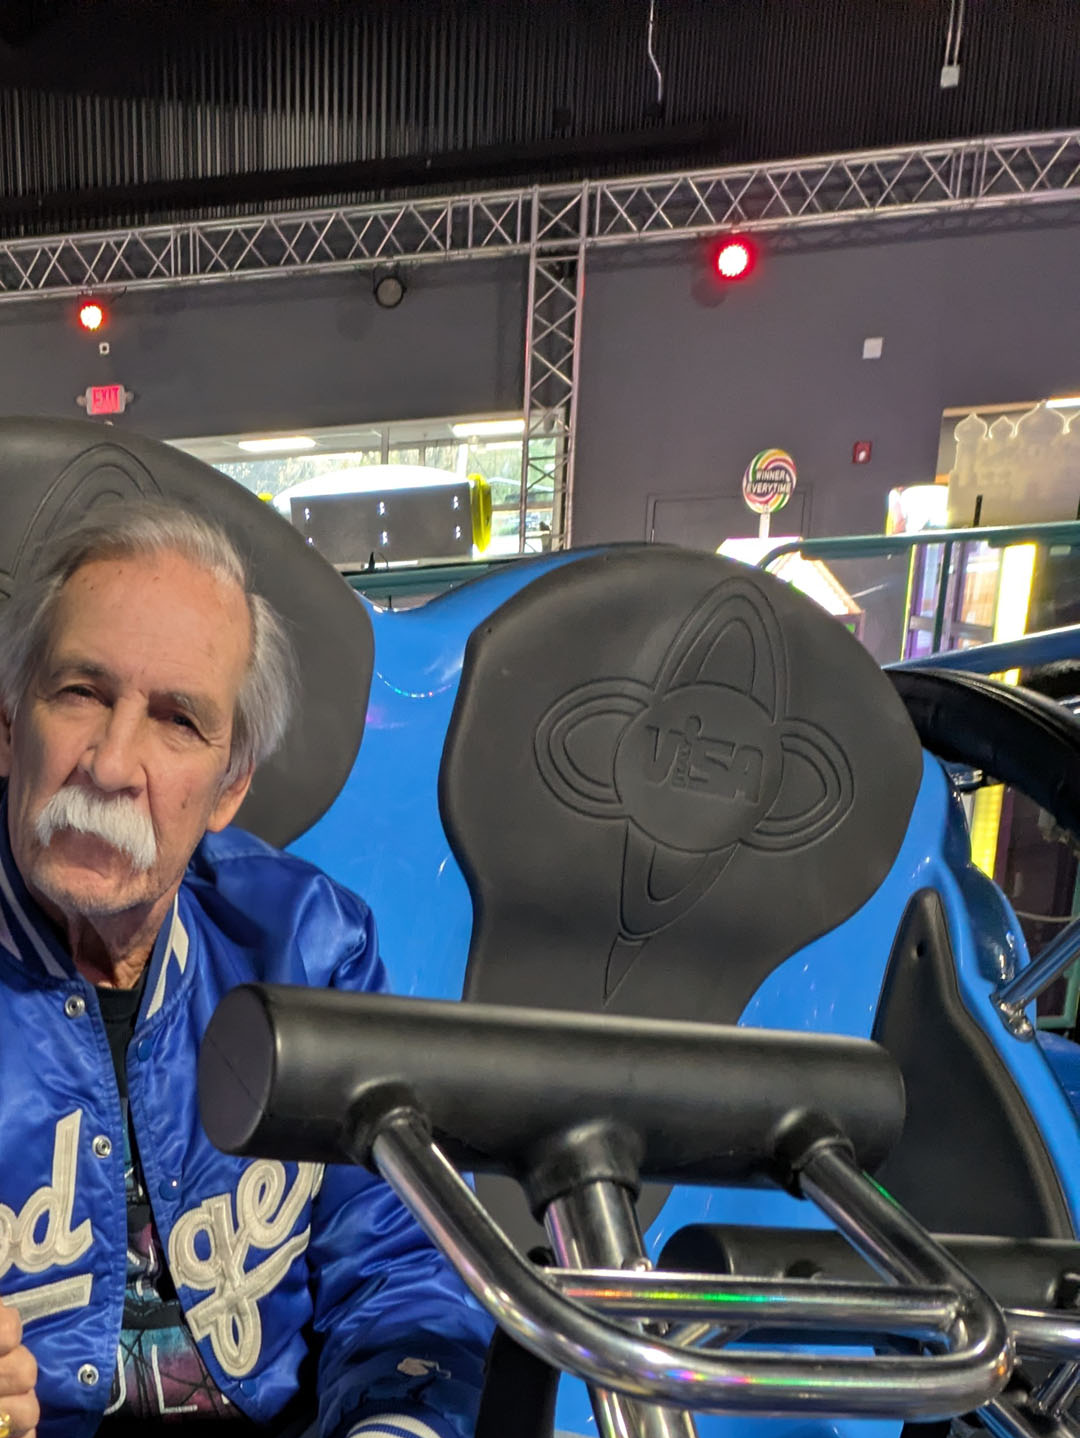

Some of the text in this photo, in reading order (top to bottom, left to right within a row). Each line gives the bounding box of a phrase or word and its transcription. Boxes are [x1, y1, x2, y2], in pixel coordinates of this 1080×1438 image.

[93, 386, 119, 410] EXIT
[756, 469, 786, 481] WINNER
[746, 482, 792, 494] EVERYTIME
